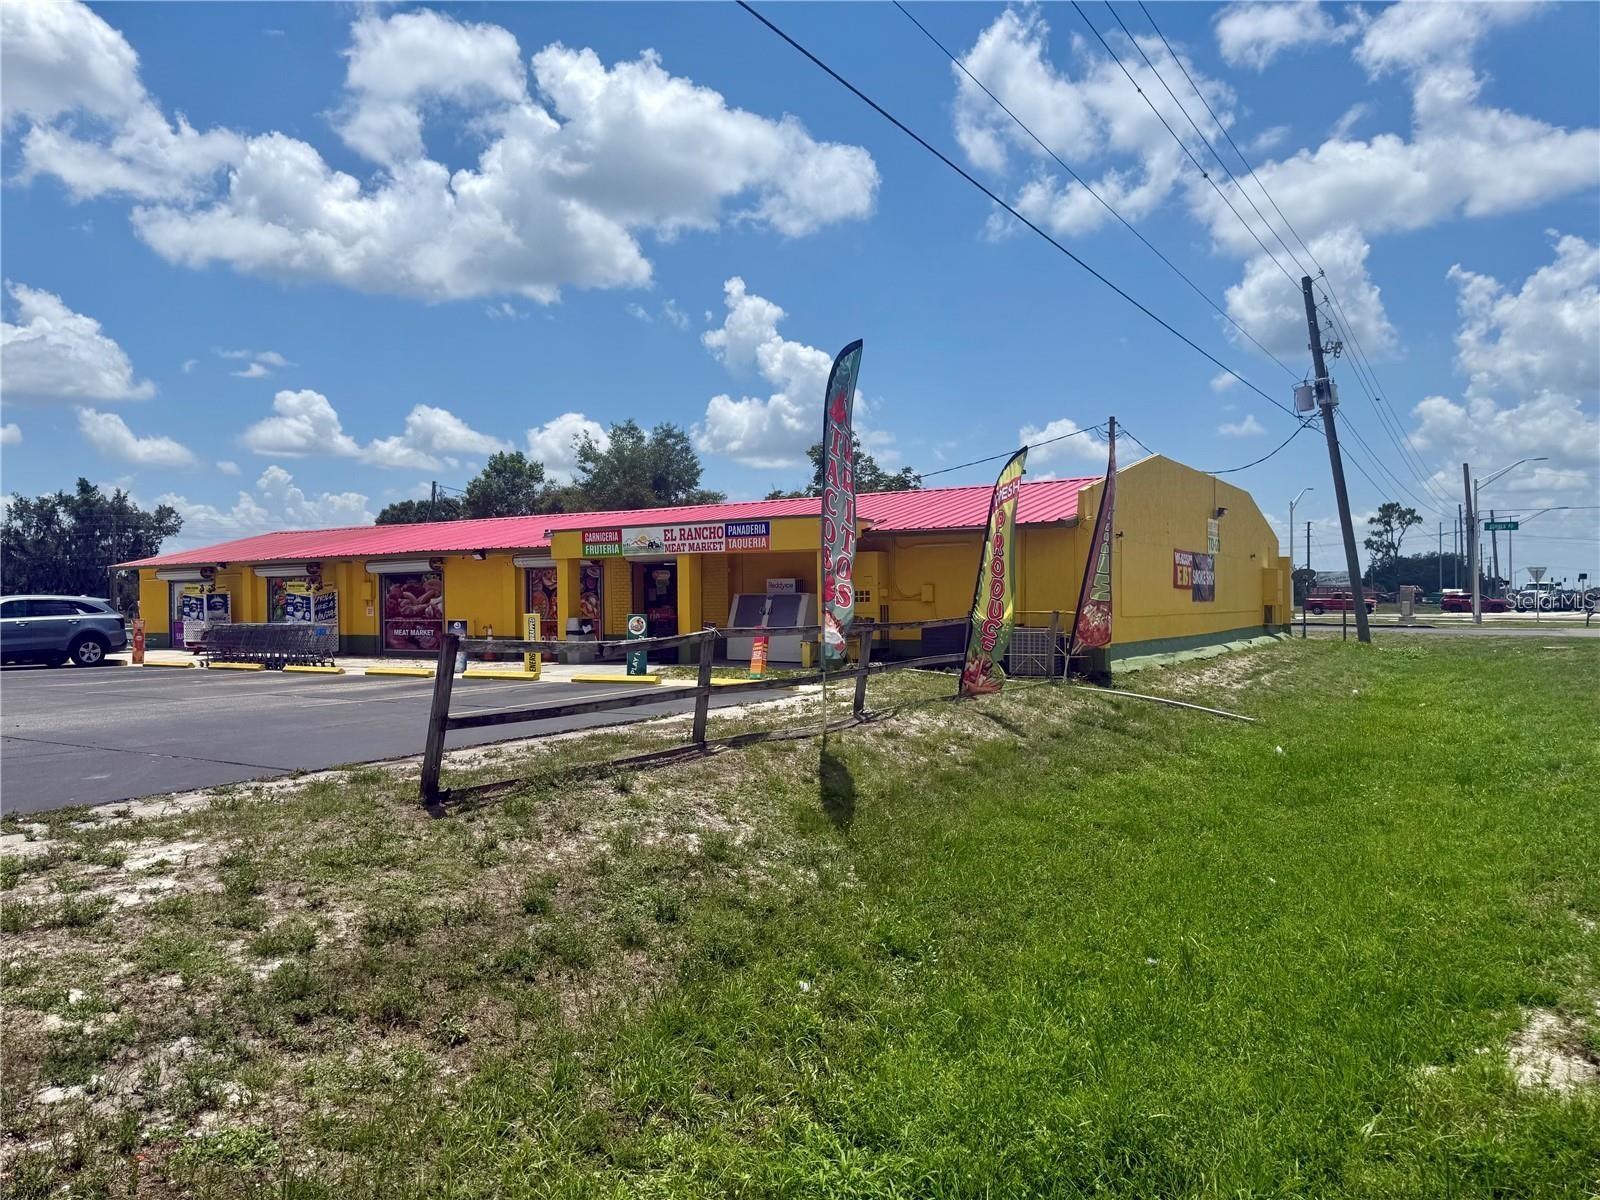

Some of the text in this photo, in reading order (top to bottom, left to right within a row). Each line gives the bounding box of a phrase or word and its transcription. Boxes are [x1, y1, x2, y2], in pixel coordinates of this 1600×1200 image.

[823, 420, 842, 572] TACOS
[584, 531, 619, 543] CARNICERIA
[663, 525, 724, 542] EL RANCHO
[727, 523, 767, 536] PANADERIA
[585, 543, 620, 556] FRUTERIA
[664, 541, 724, 554] MEAT MARKET
[727, 537, 767, 549] TAQUERIA
[980, 510, 1006, 652] PRODUCE
[1177, 566, 1192, 586] EBT
[630, 657, 639, 675] PLAY
